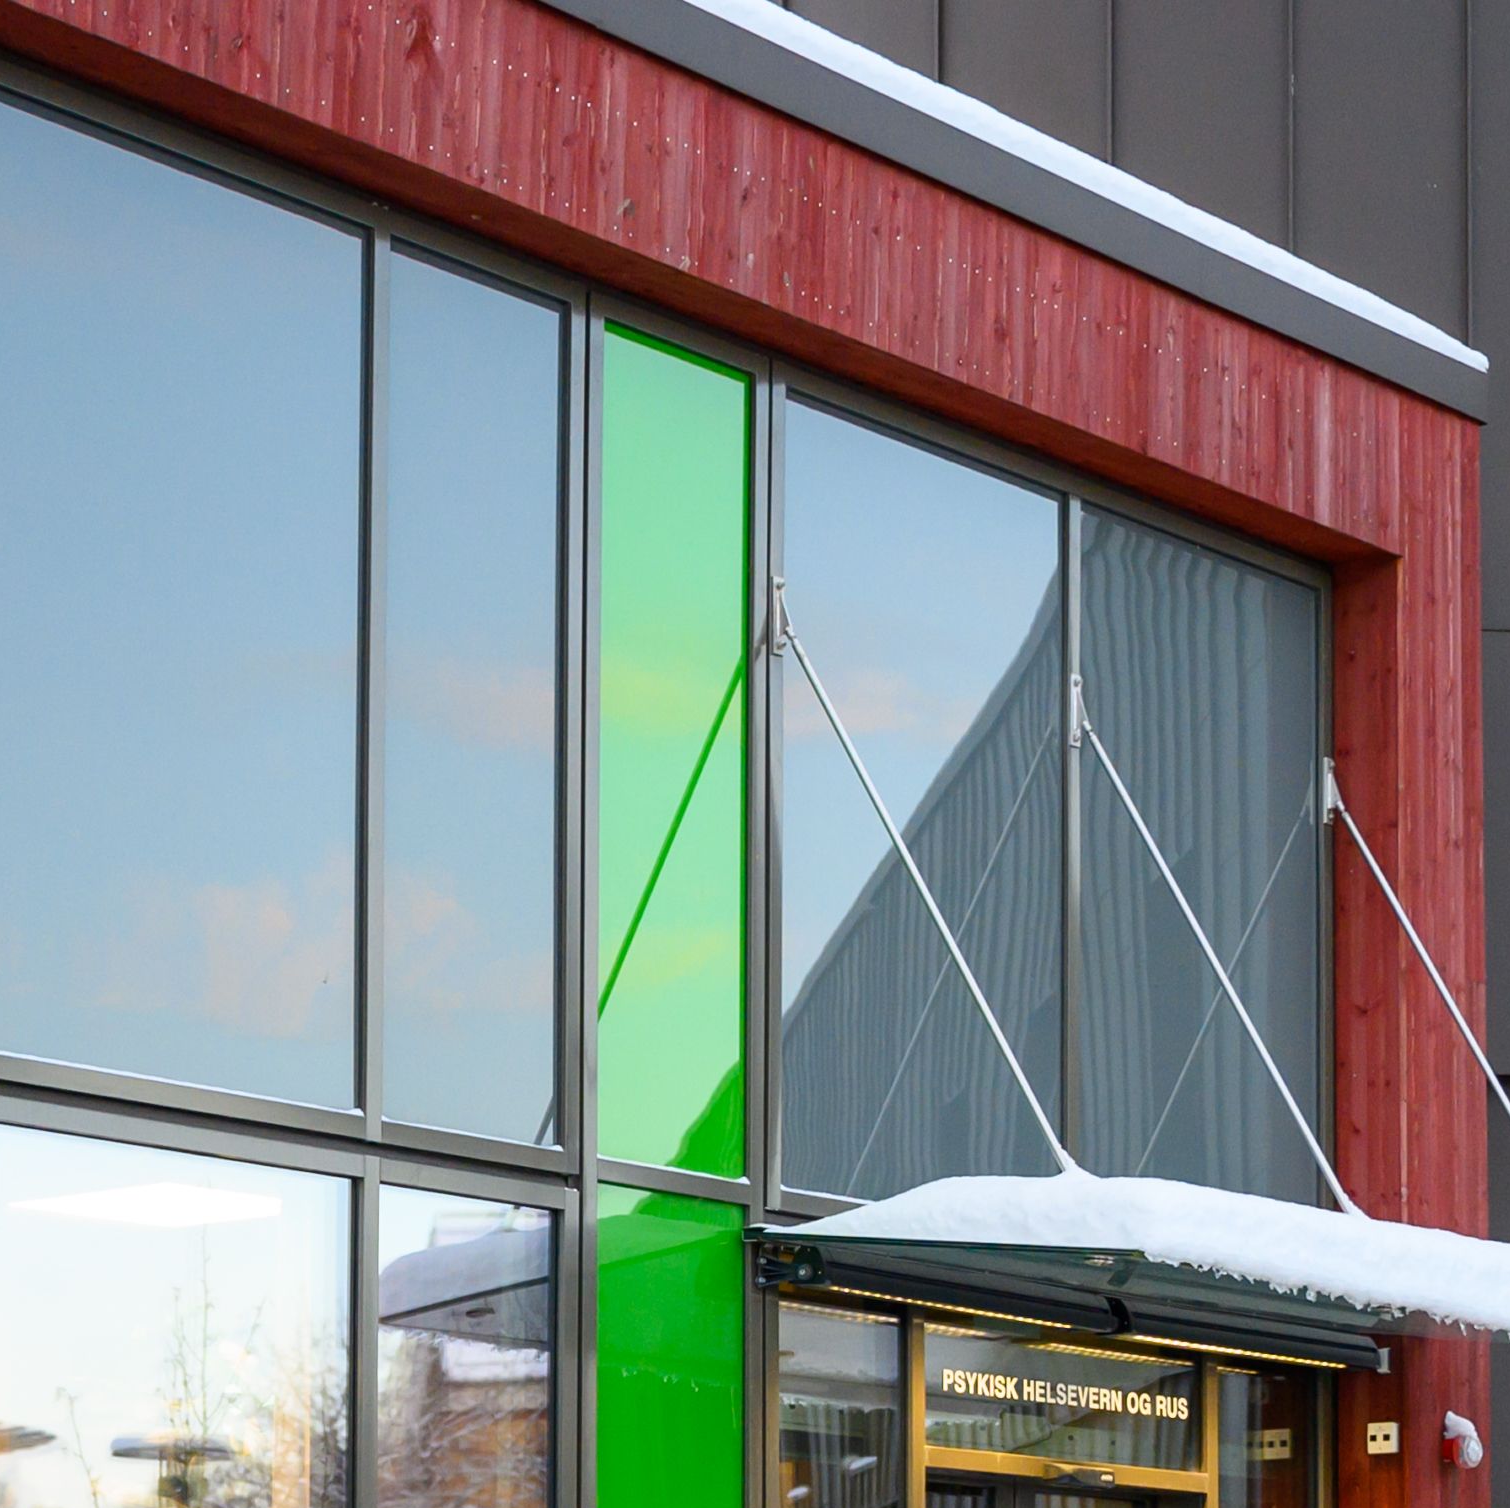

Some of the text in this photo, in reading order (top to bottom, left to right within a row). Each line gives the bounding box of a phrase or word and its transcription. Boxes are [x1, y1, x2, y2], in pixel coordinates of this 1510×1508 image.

[942, 1368, 1189, 1420] PSYKISK HELSEVERN OG RUS
